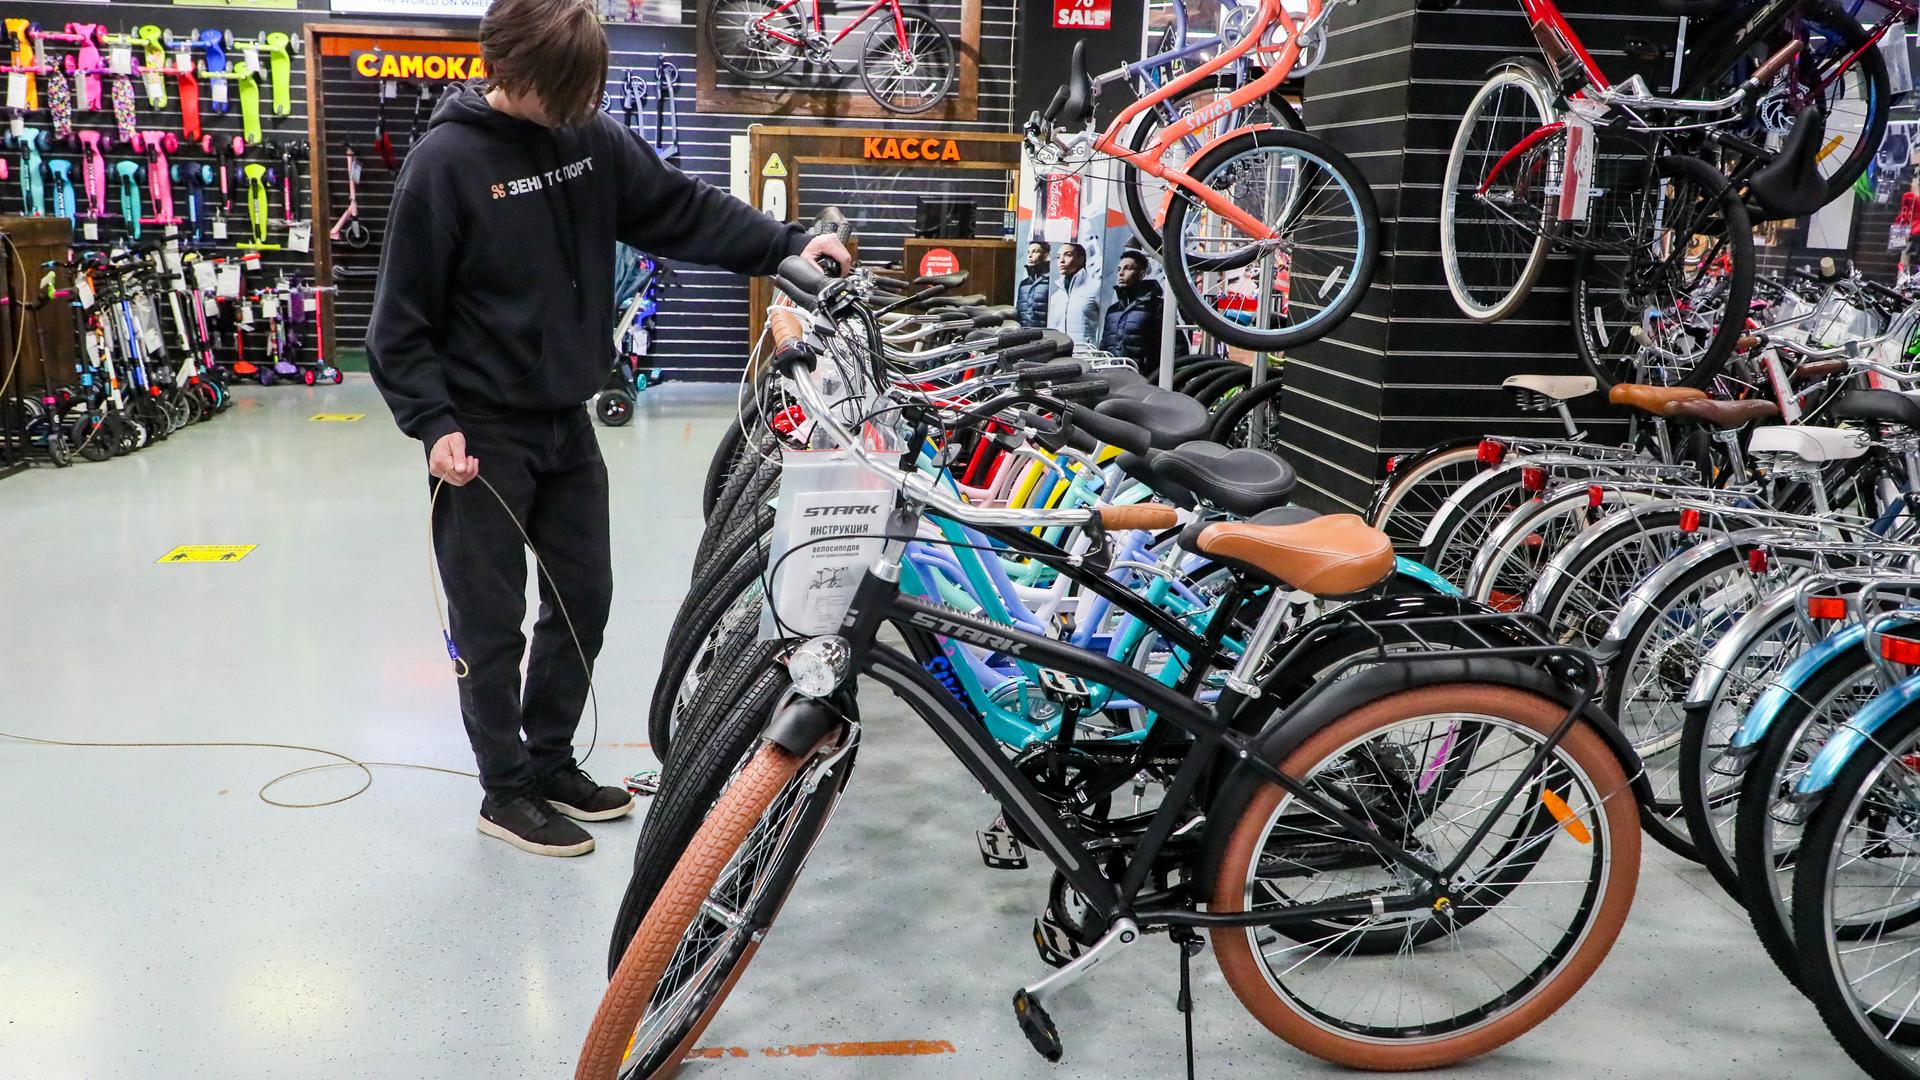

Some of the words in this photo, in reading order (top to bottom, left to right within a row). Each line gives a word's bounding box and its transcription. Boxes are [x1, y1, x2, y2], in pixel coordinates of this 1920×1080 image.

[1058, 8, 1105, 26] SALE
[356, 53, 488, 80] САМОКА
[863, 137, 961, 161] КАССА
[803, 504, 880, 517] STARK
[810, 524, 869, 536] ИНСТРУКЦИЯ
[812, 544, 860, 553] велосипедов
[909, 610, 1028, 655] STARK
